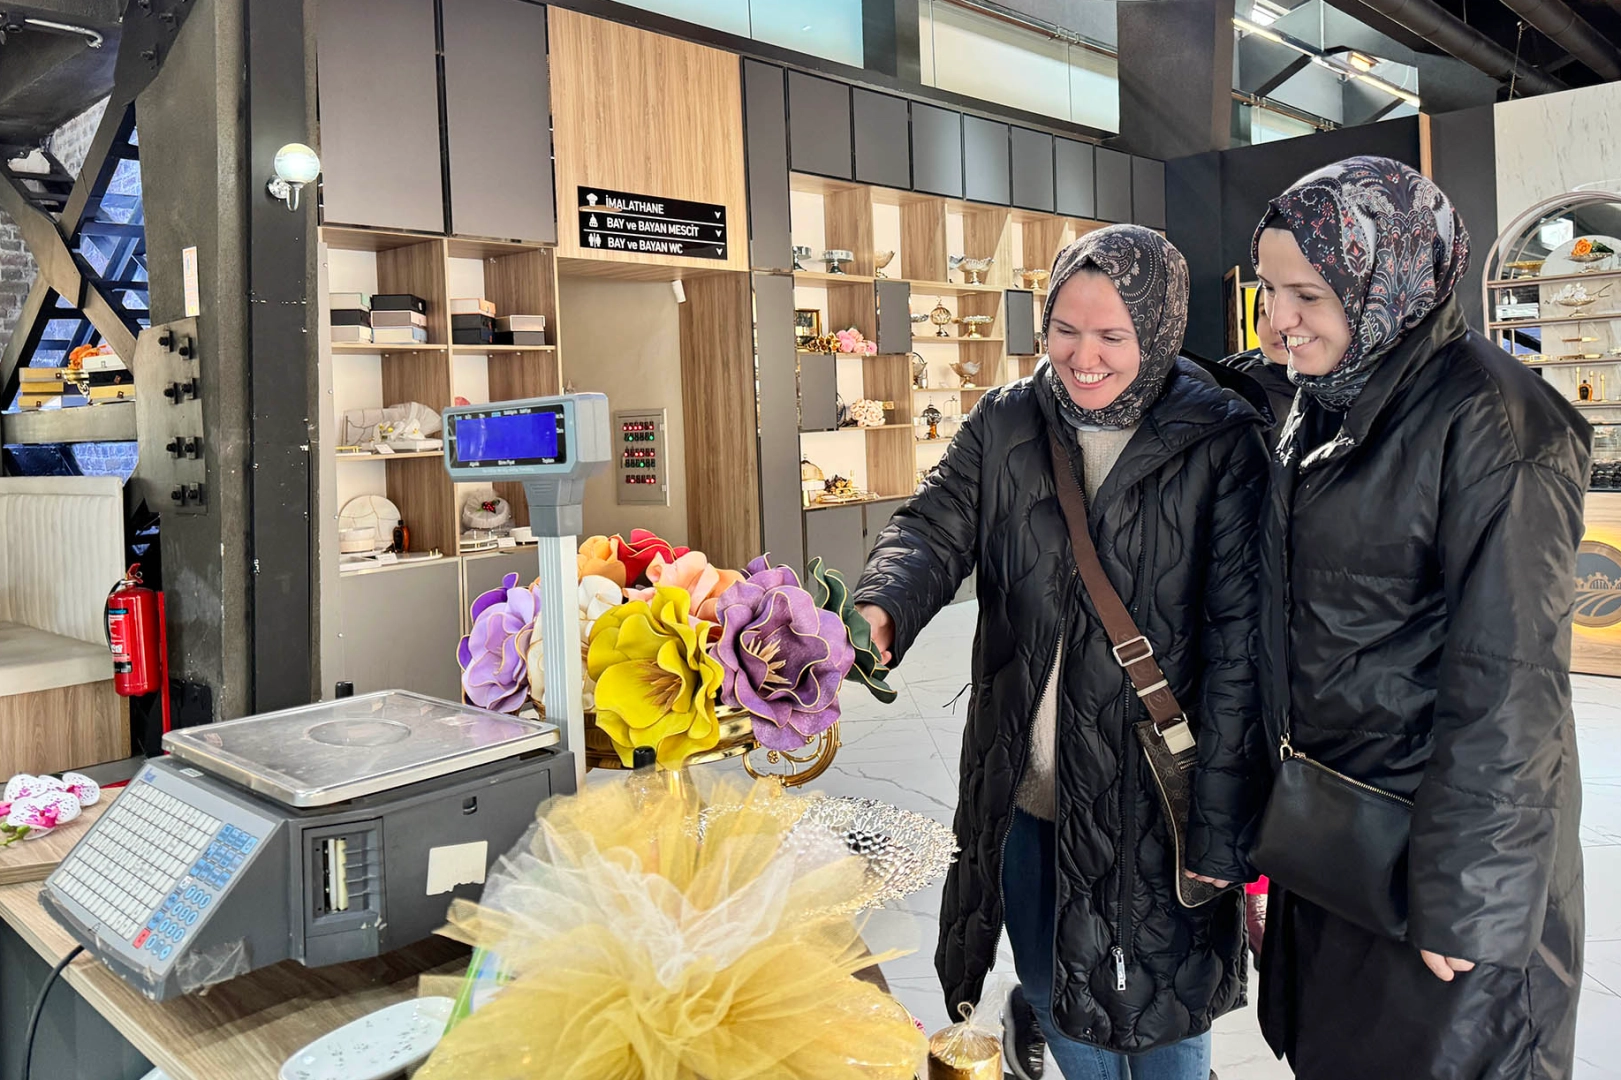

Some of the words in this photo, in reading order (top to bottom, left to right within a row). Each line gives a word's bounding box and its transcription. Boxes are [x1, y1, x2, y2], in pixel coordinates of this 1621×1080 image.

[605, 195, 664, 214] İMALATHANE
[606, 217, 625, 230] BAY
[626, 221, 637, 231] ve
[638, 220, 667, 234] BAYAN
[668, 224, 699, 237] MESCİT
[607, 236, 626, 249] BAY
[627, 241, 638, 250] ve
[639, 240, 668, 253] BAYAN
[669, 242, 683, 254] WC
